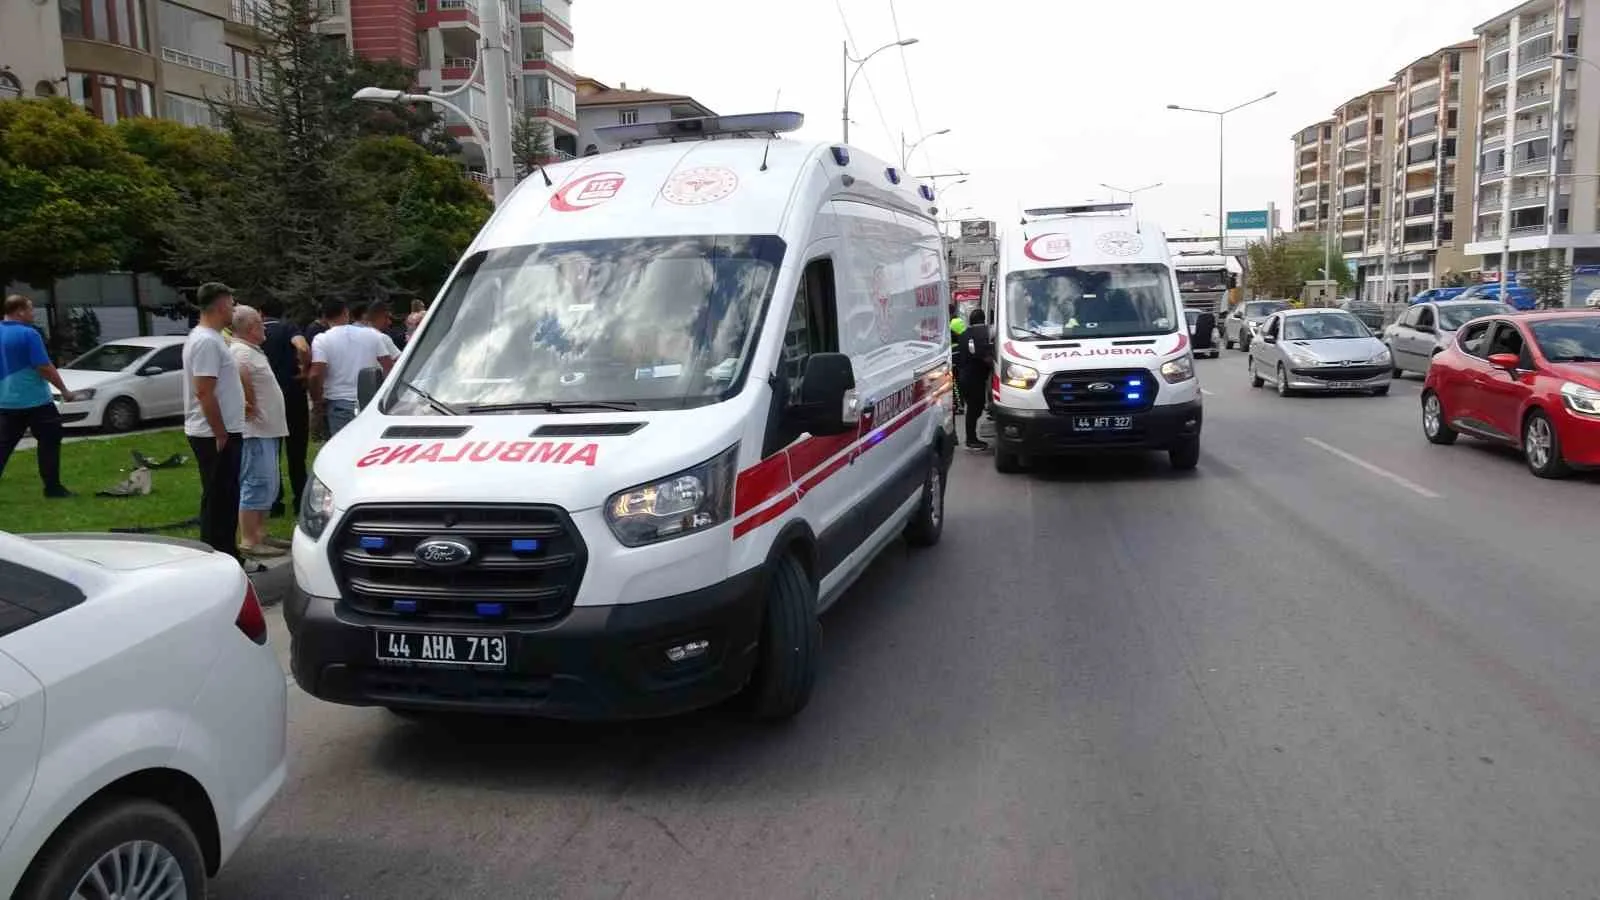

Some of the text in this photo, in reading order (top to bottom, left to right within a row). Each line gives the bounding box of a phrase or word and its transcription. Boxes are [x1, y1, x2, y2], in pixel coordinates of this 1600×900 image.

[1079, 418, 1090, 427] 44
[1114, 417, 1130, 427] 327
[388, 633, 503, 661] 44 AHA 713
